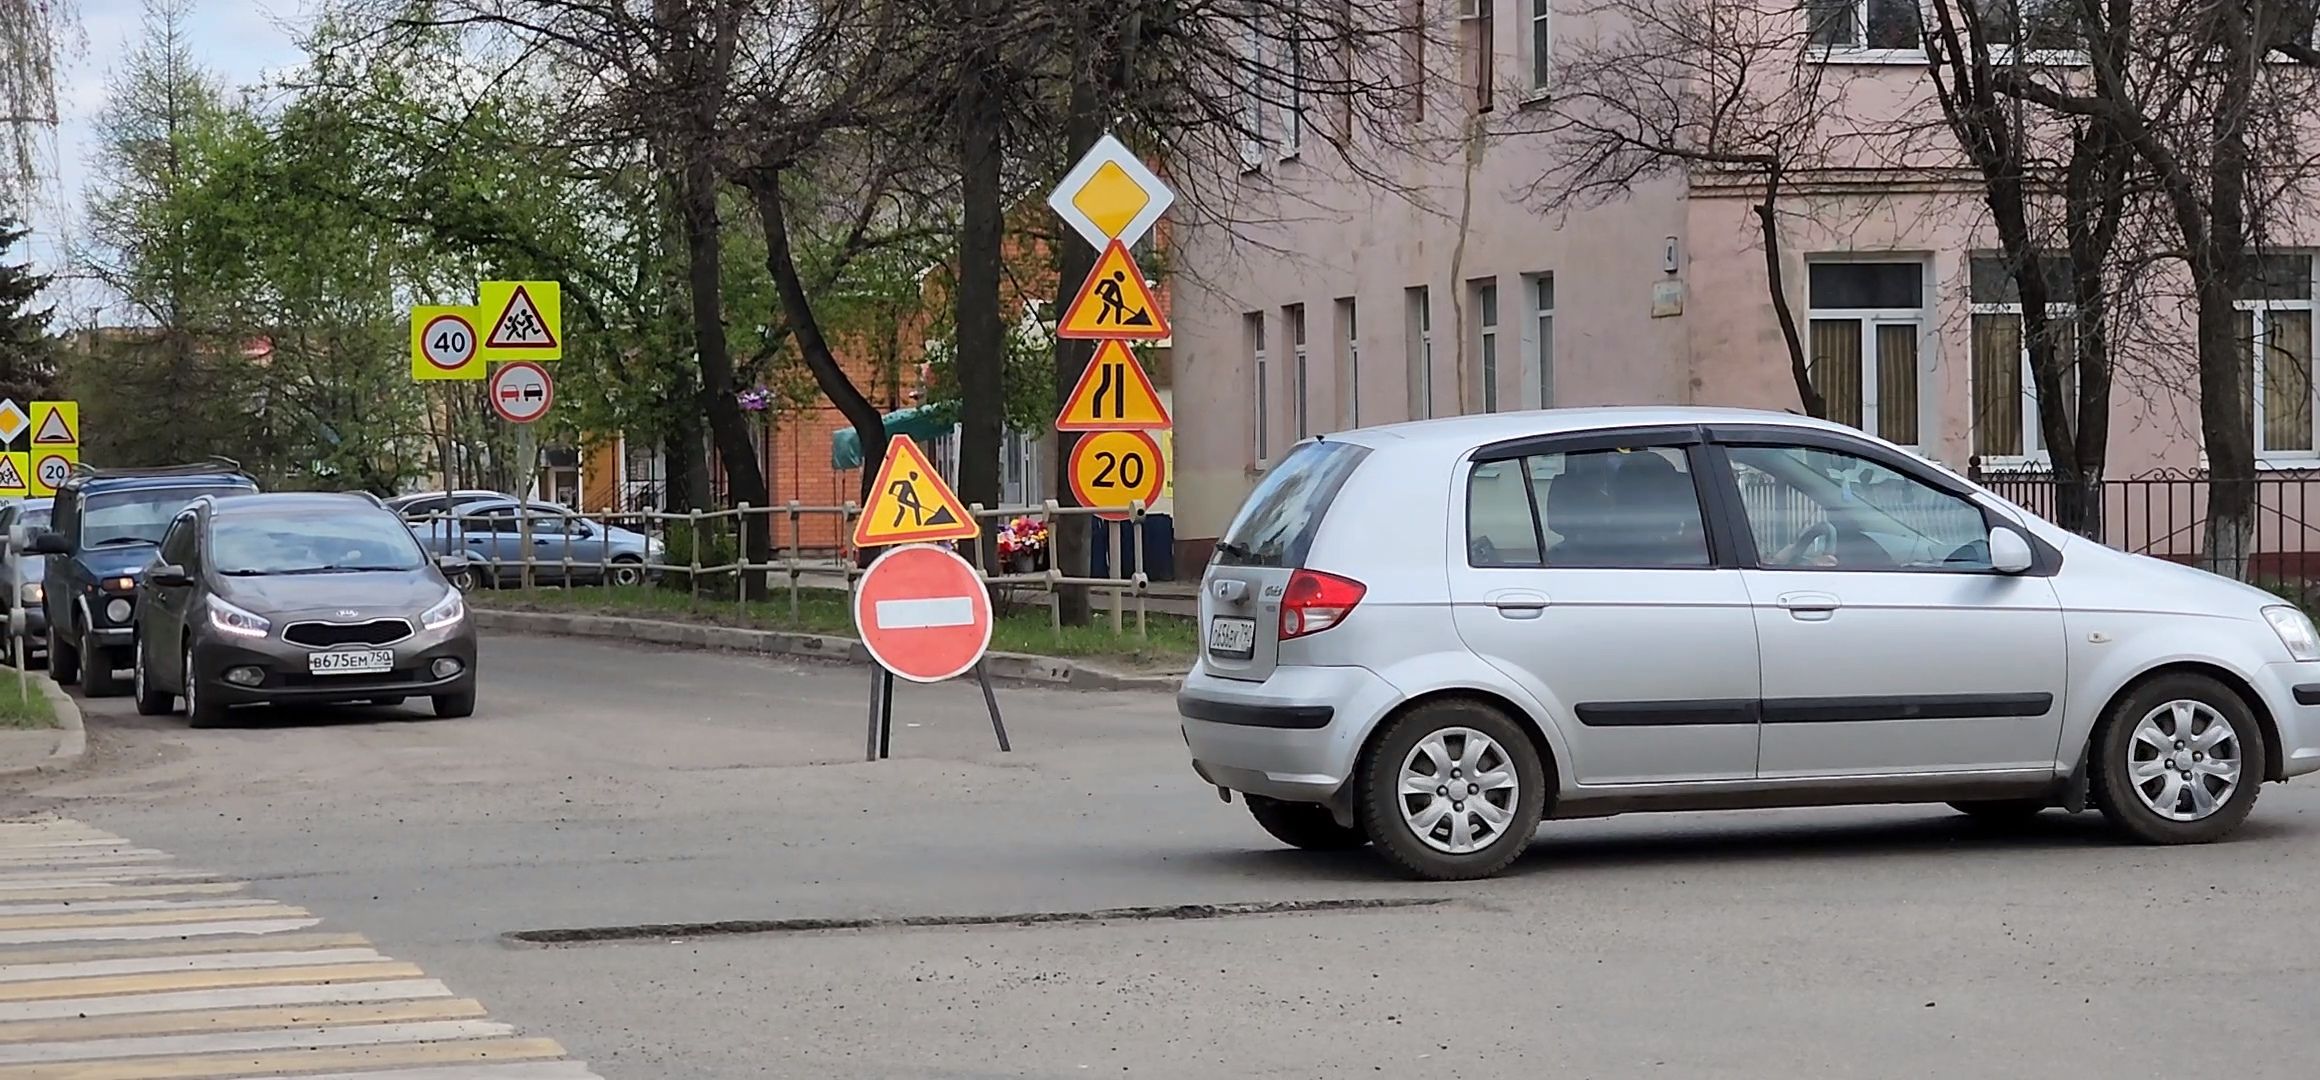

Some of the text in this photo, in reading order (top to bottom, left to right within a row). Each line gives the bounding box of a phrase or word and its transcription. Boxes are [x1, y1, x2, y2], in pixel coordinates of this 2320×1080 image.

[434, 332, 465, 353] 40
[45, 465, 65, 479] 20
[1092, 451, 1144, 489] 20
